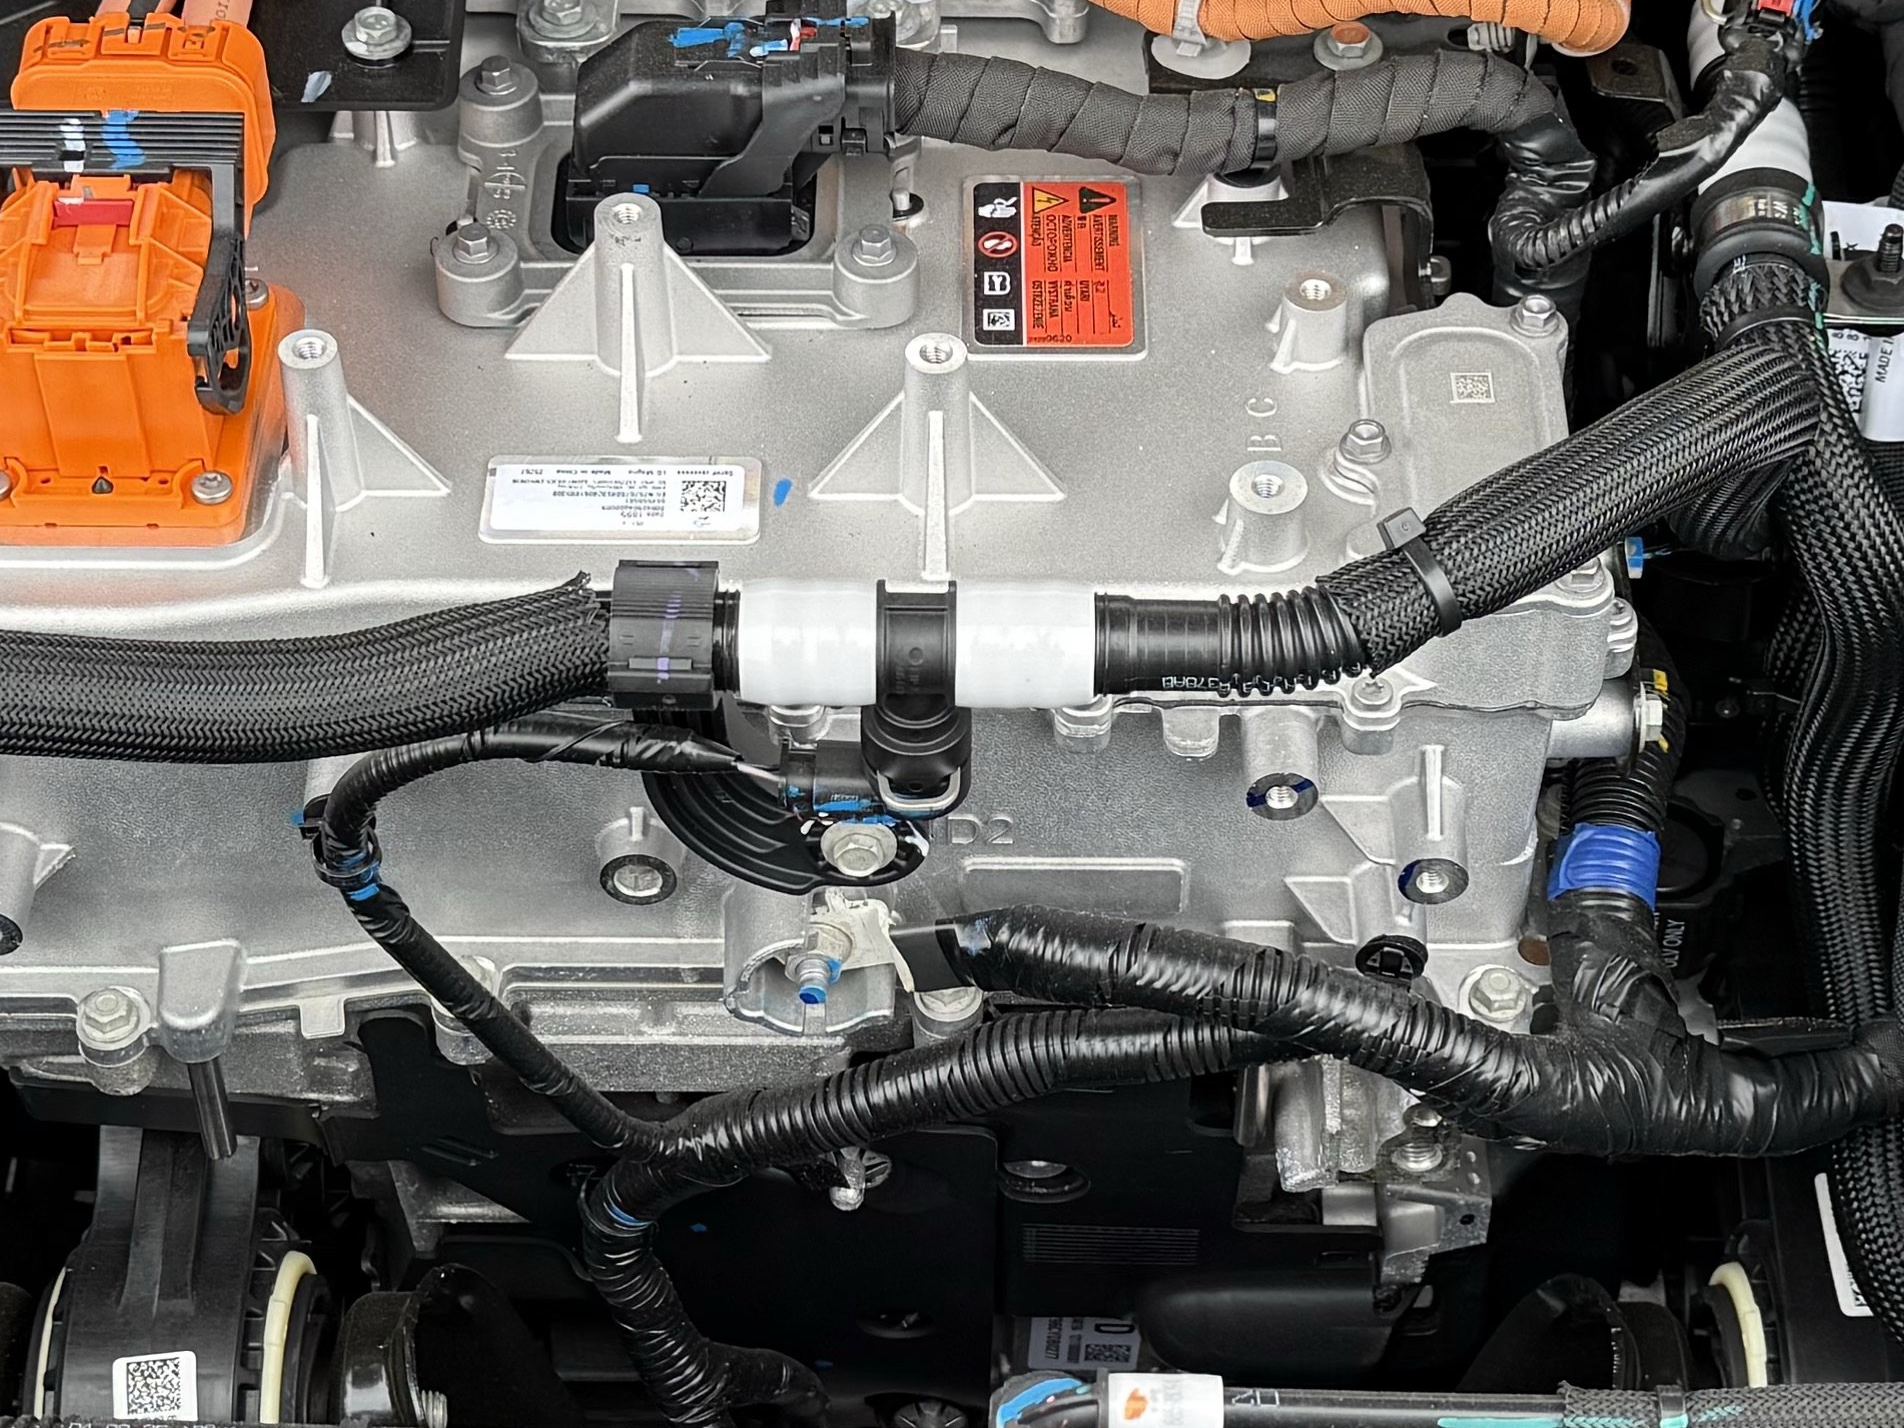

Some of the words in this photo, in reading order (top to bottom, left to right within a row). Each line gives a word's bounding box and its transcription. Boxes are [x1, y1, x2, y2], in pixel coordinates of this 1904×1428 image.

[1875, 348, 1893, 383] MADE
[1245, 397, 1277, 418] C
[947, 813, 1015, 845] D2
